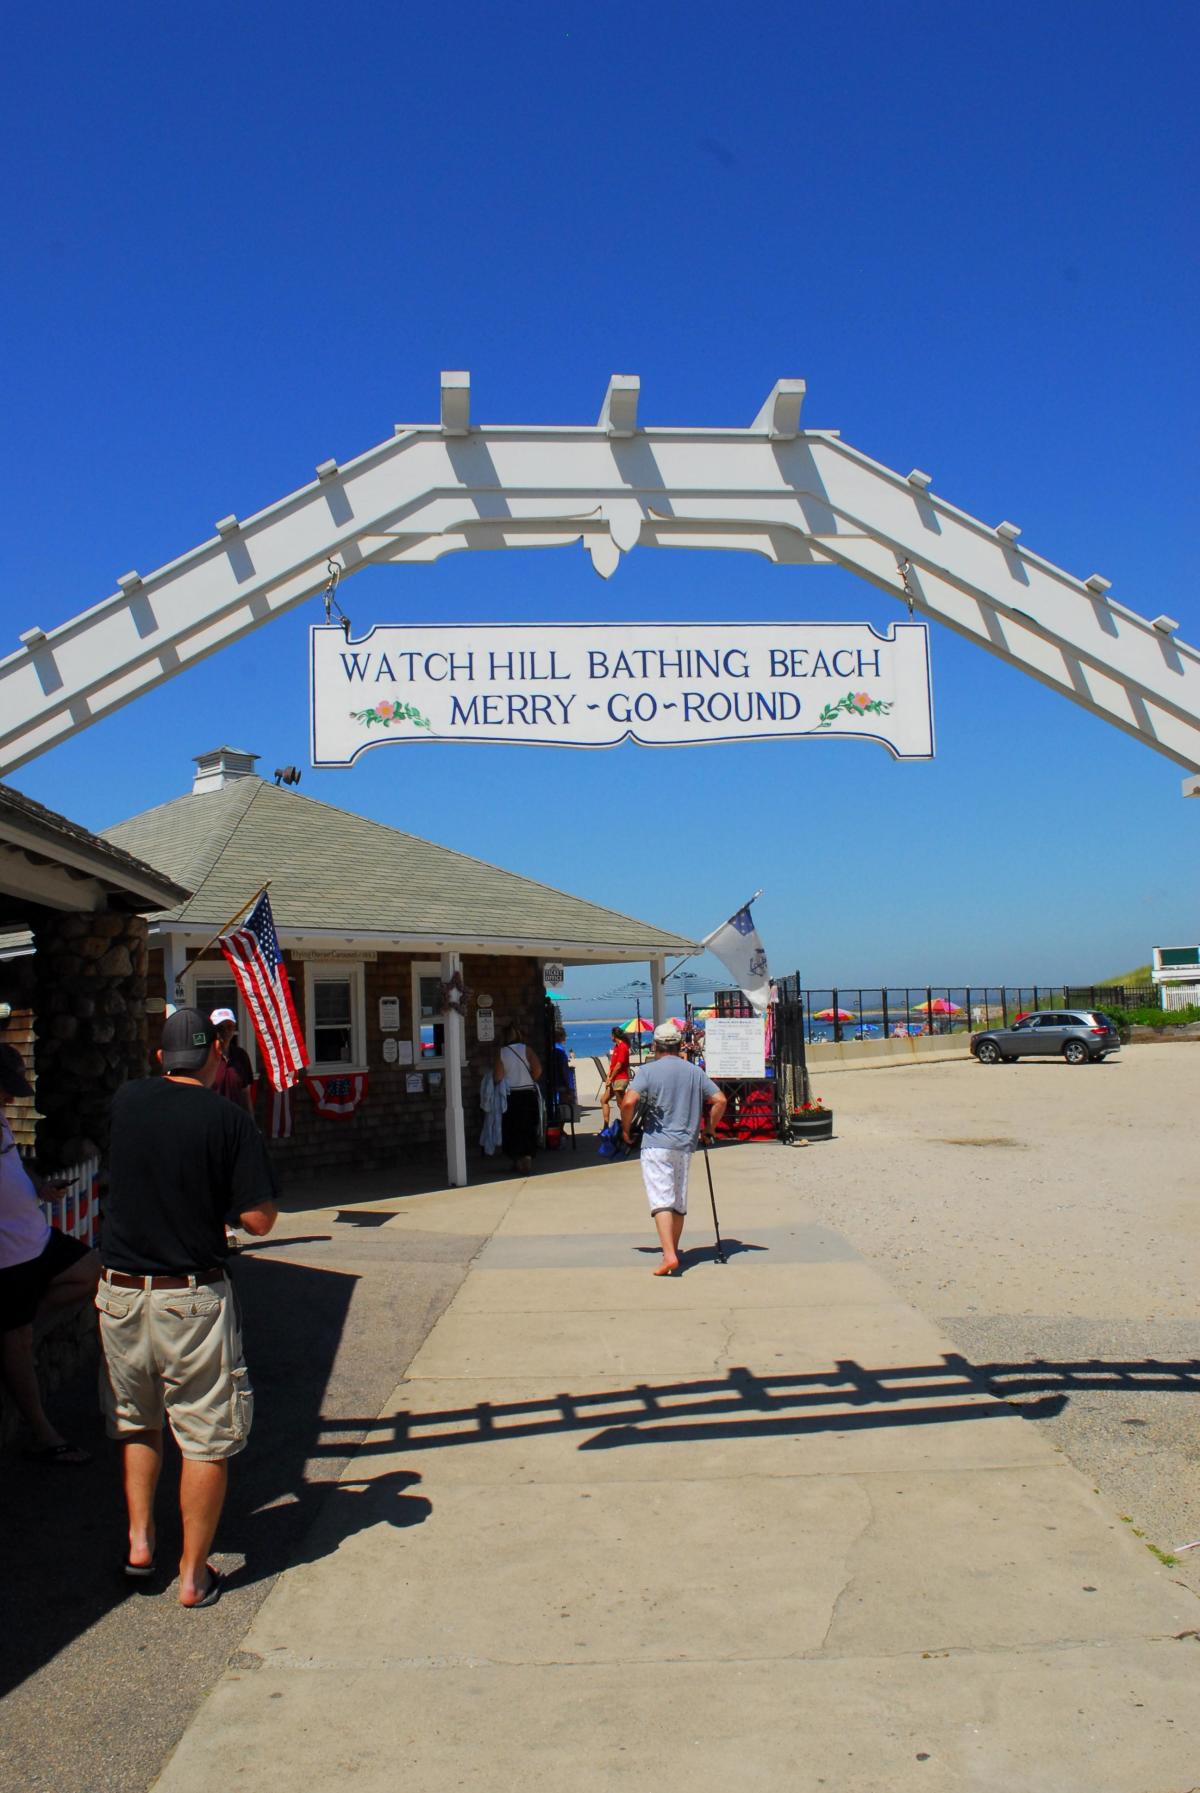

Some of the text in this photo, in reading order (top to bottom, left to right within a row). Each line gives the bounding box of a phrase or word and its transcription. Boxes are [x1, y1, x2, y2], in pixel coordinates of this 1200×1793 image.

[340, 649, 881, 682] WATCH HILL BATHING BEACH
